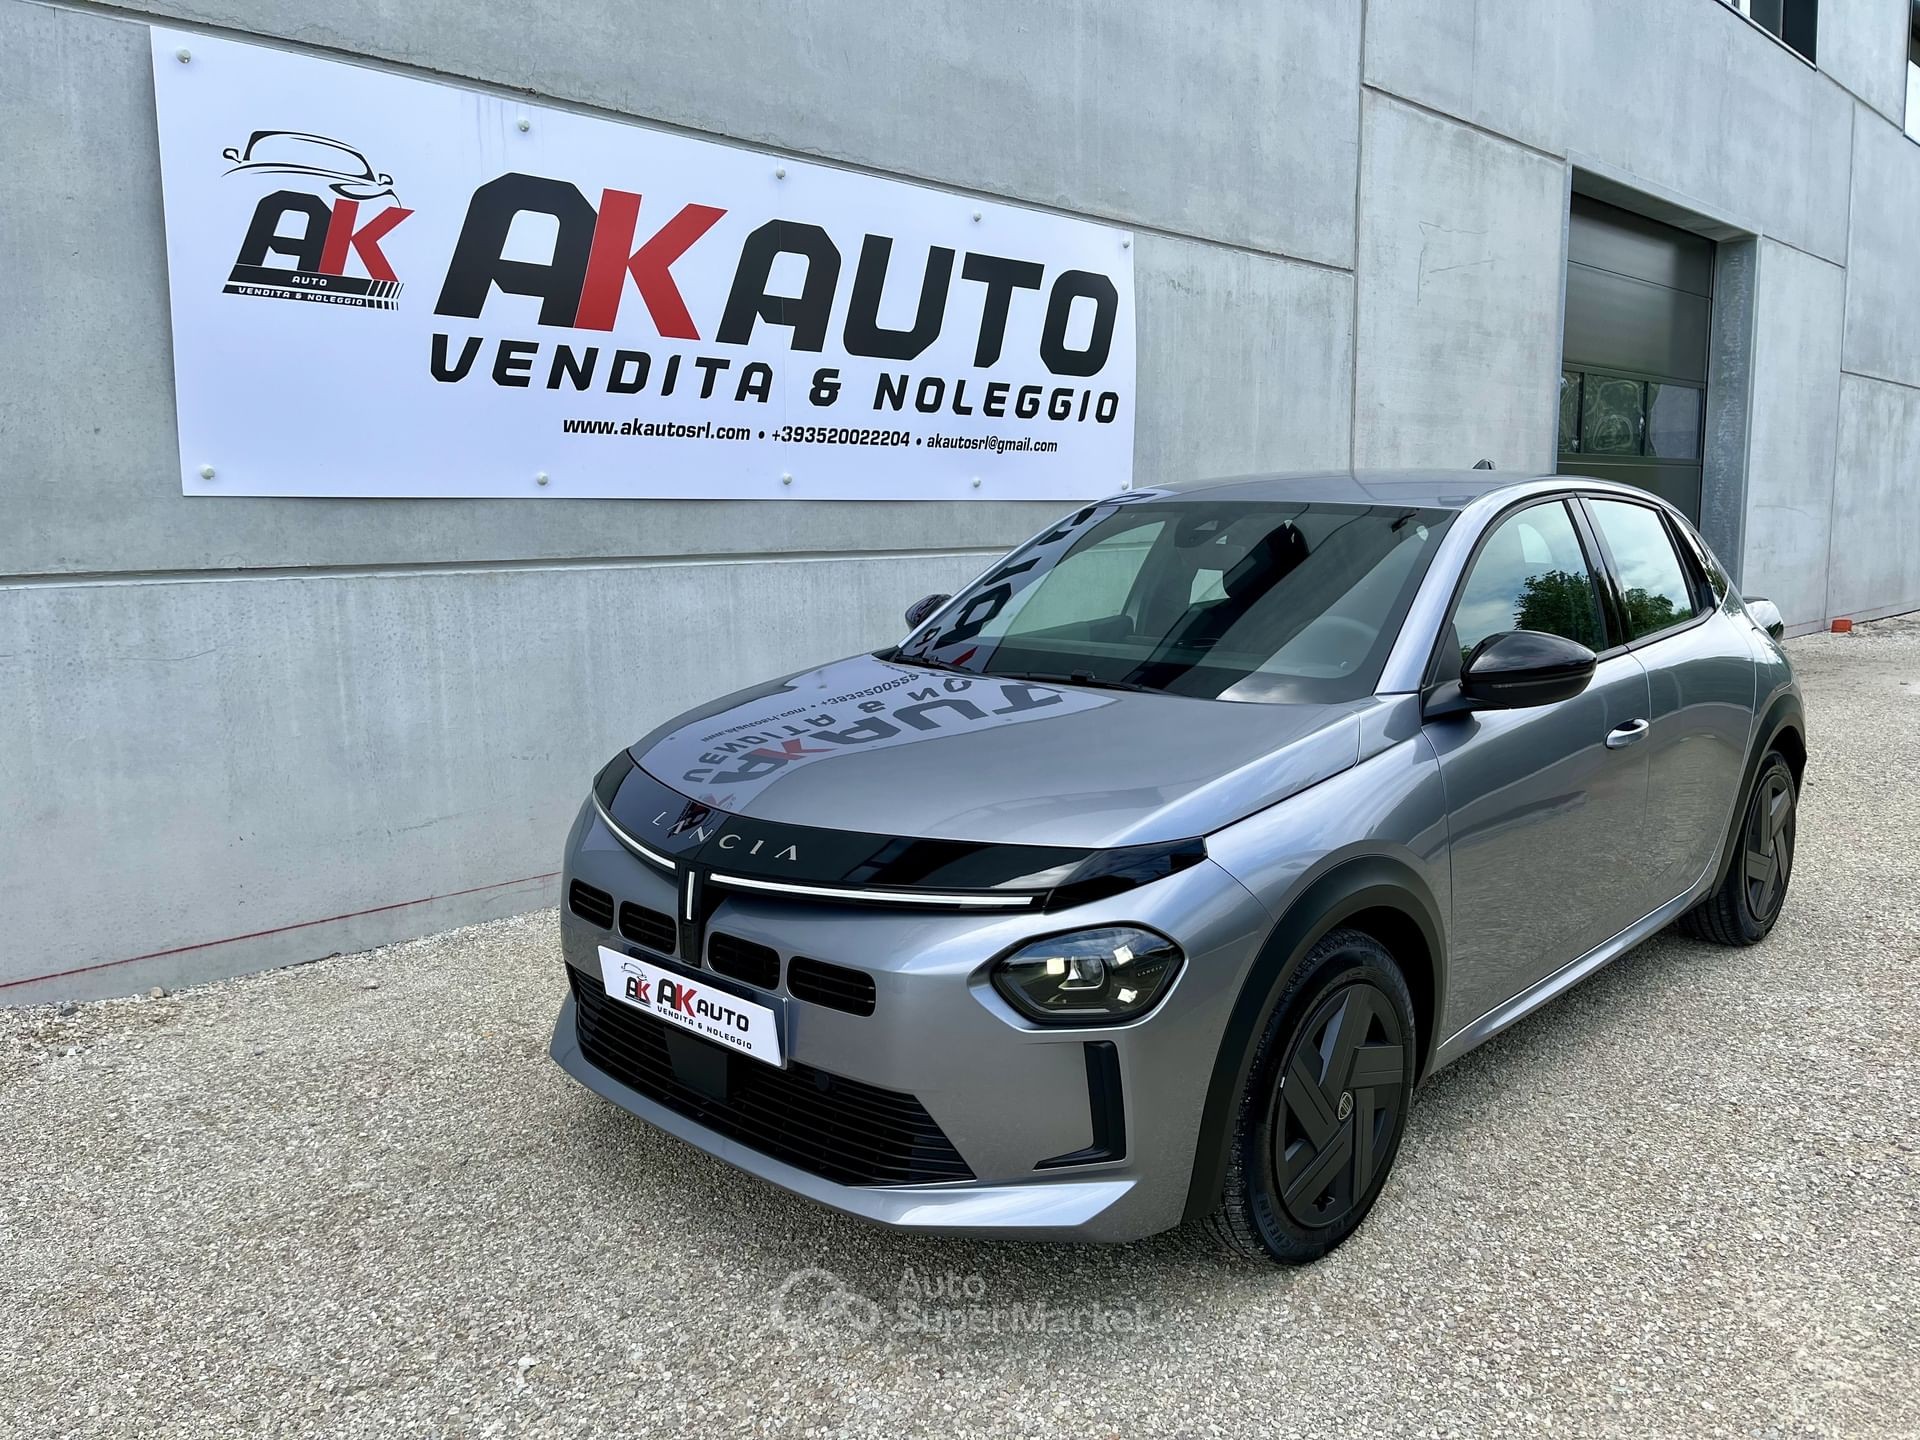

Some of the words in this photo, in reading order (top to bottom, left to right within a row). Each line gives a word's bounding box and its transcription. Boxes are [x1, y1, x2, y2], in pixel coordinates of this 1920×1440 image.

[236, 189, 416, 283] AK
[238, 286, 290, 299] VENDITA
[295, 292, 302, 300] &
[307, 293, 363, 306] NOLEGGIO
[291, 275, 328, 287] AUTO
[429, 333, 774, 403] VENDITA
[808, 368, 842, 407] &
[872, 372, 1120, 424] NOLEGGIO
[563, 418, 751, 441] www.akautosrl.com
[771, 425, 911, 447] +393520022204
[926, 433, 1059, 455] akautosrl@gmail.com
[651, 811, 798, 861] LANCIA
[657, 1005, 694, 1026] VENDITA
[706, 1026, 752, 1050] NOLEGGIO
